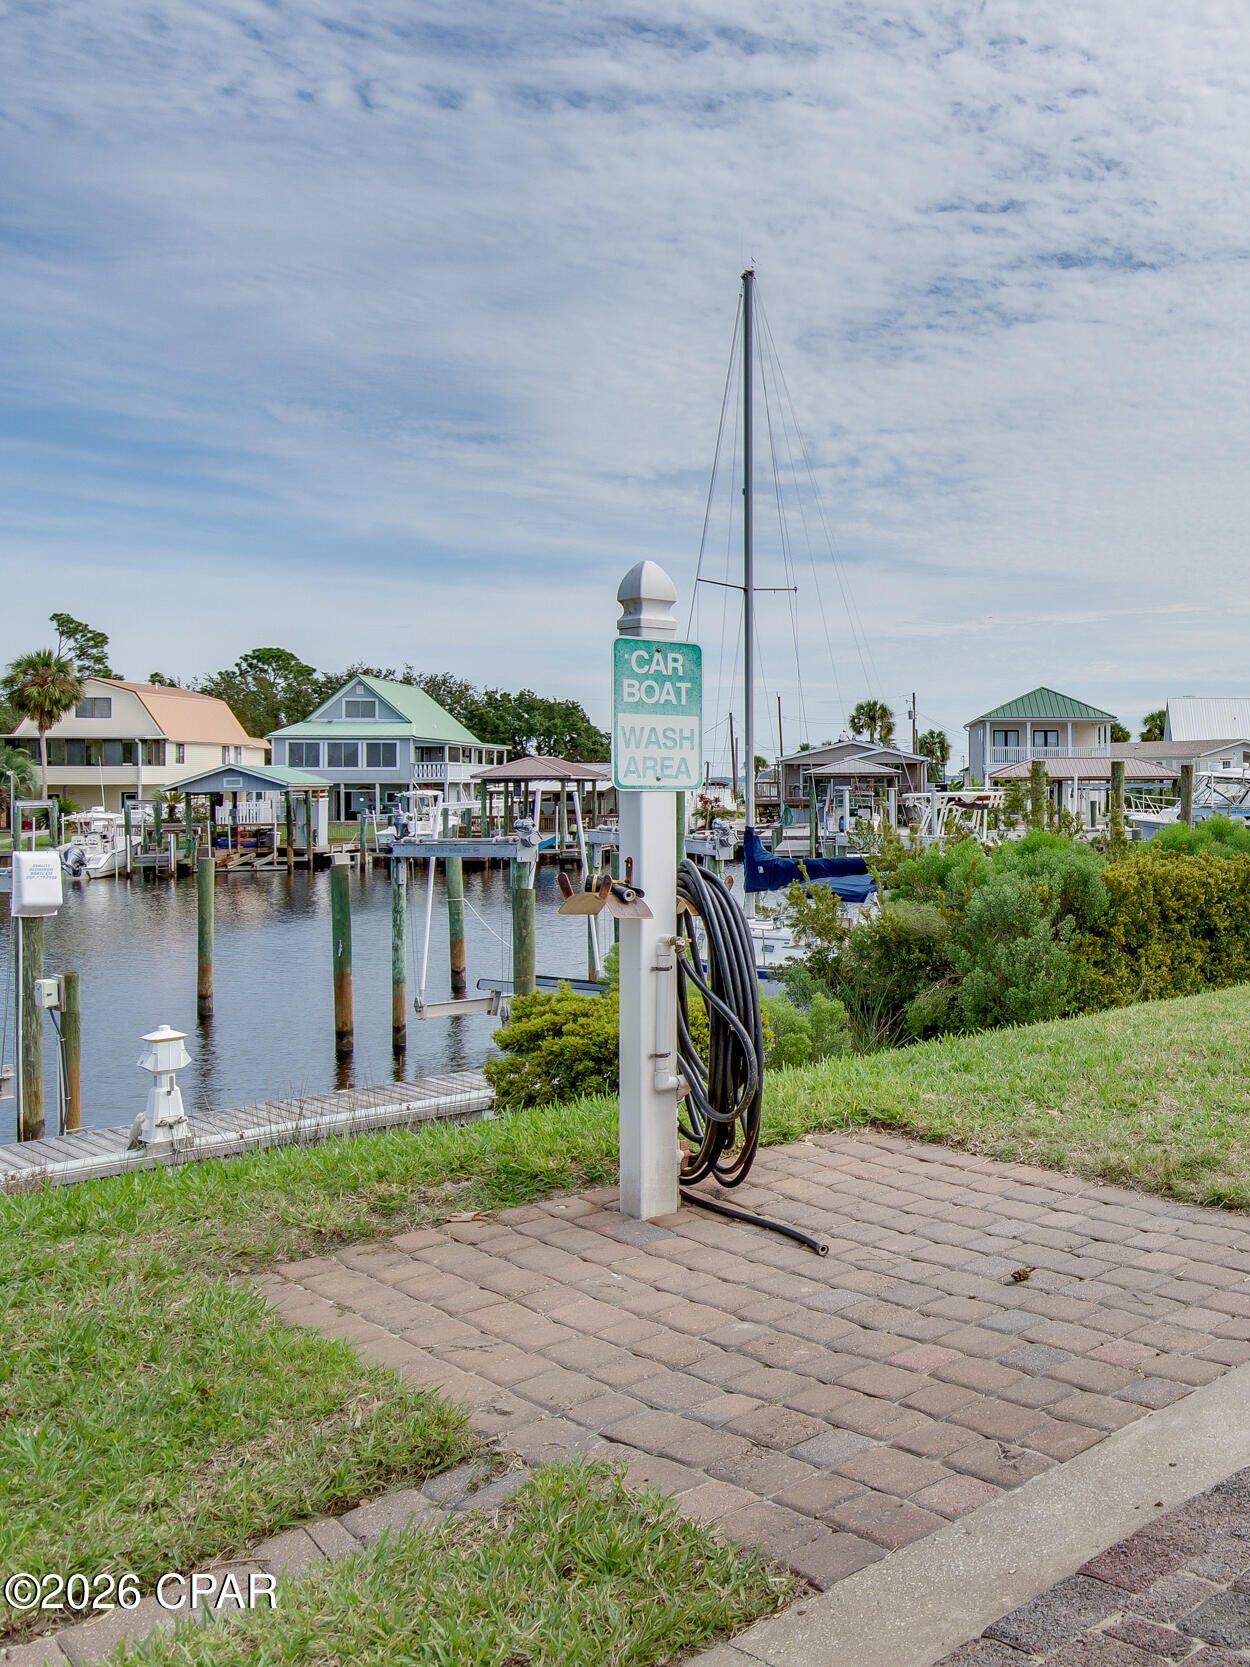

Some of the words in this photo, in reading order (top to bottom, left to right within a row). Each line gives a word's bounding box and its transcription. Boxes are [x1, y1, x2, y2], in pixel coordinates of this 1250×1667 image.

[631, 650, 684, 676] CAR
[623, 679, 692, 705] BOAT
[620, 725, 695, 751] WASH
[623, 755, 692, 780] AREA
